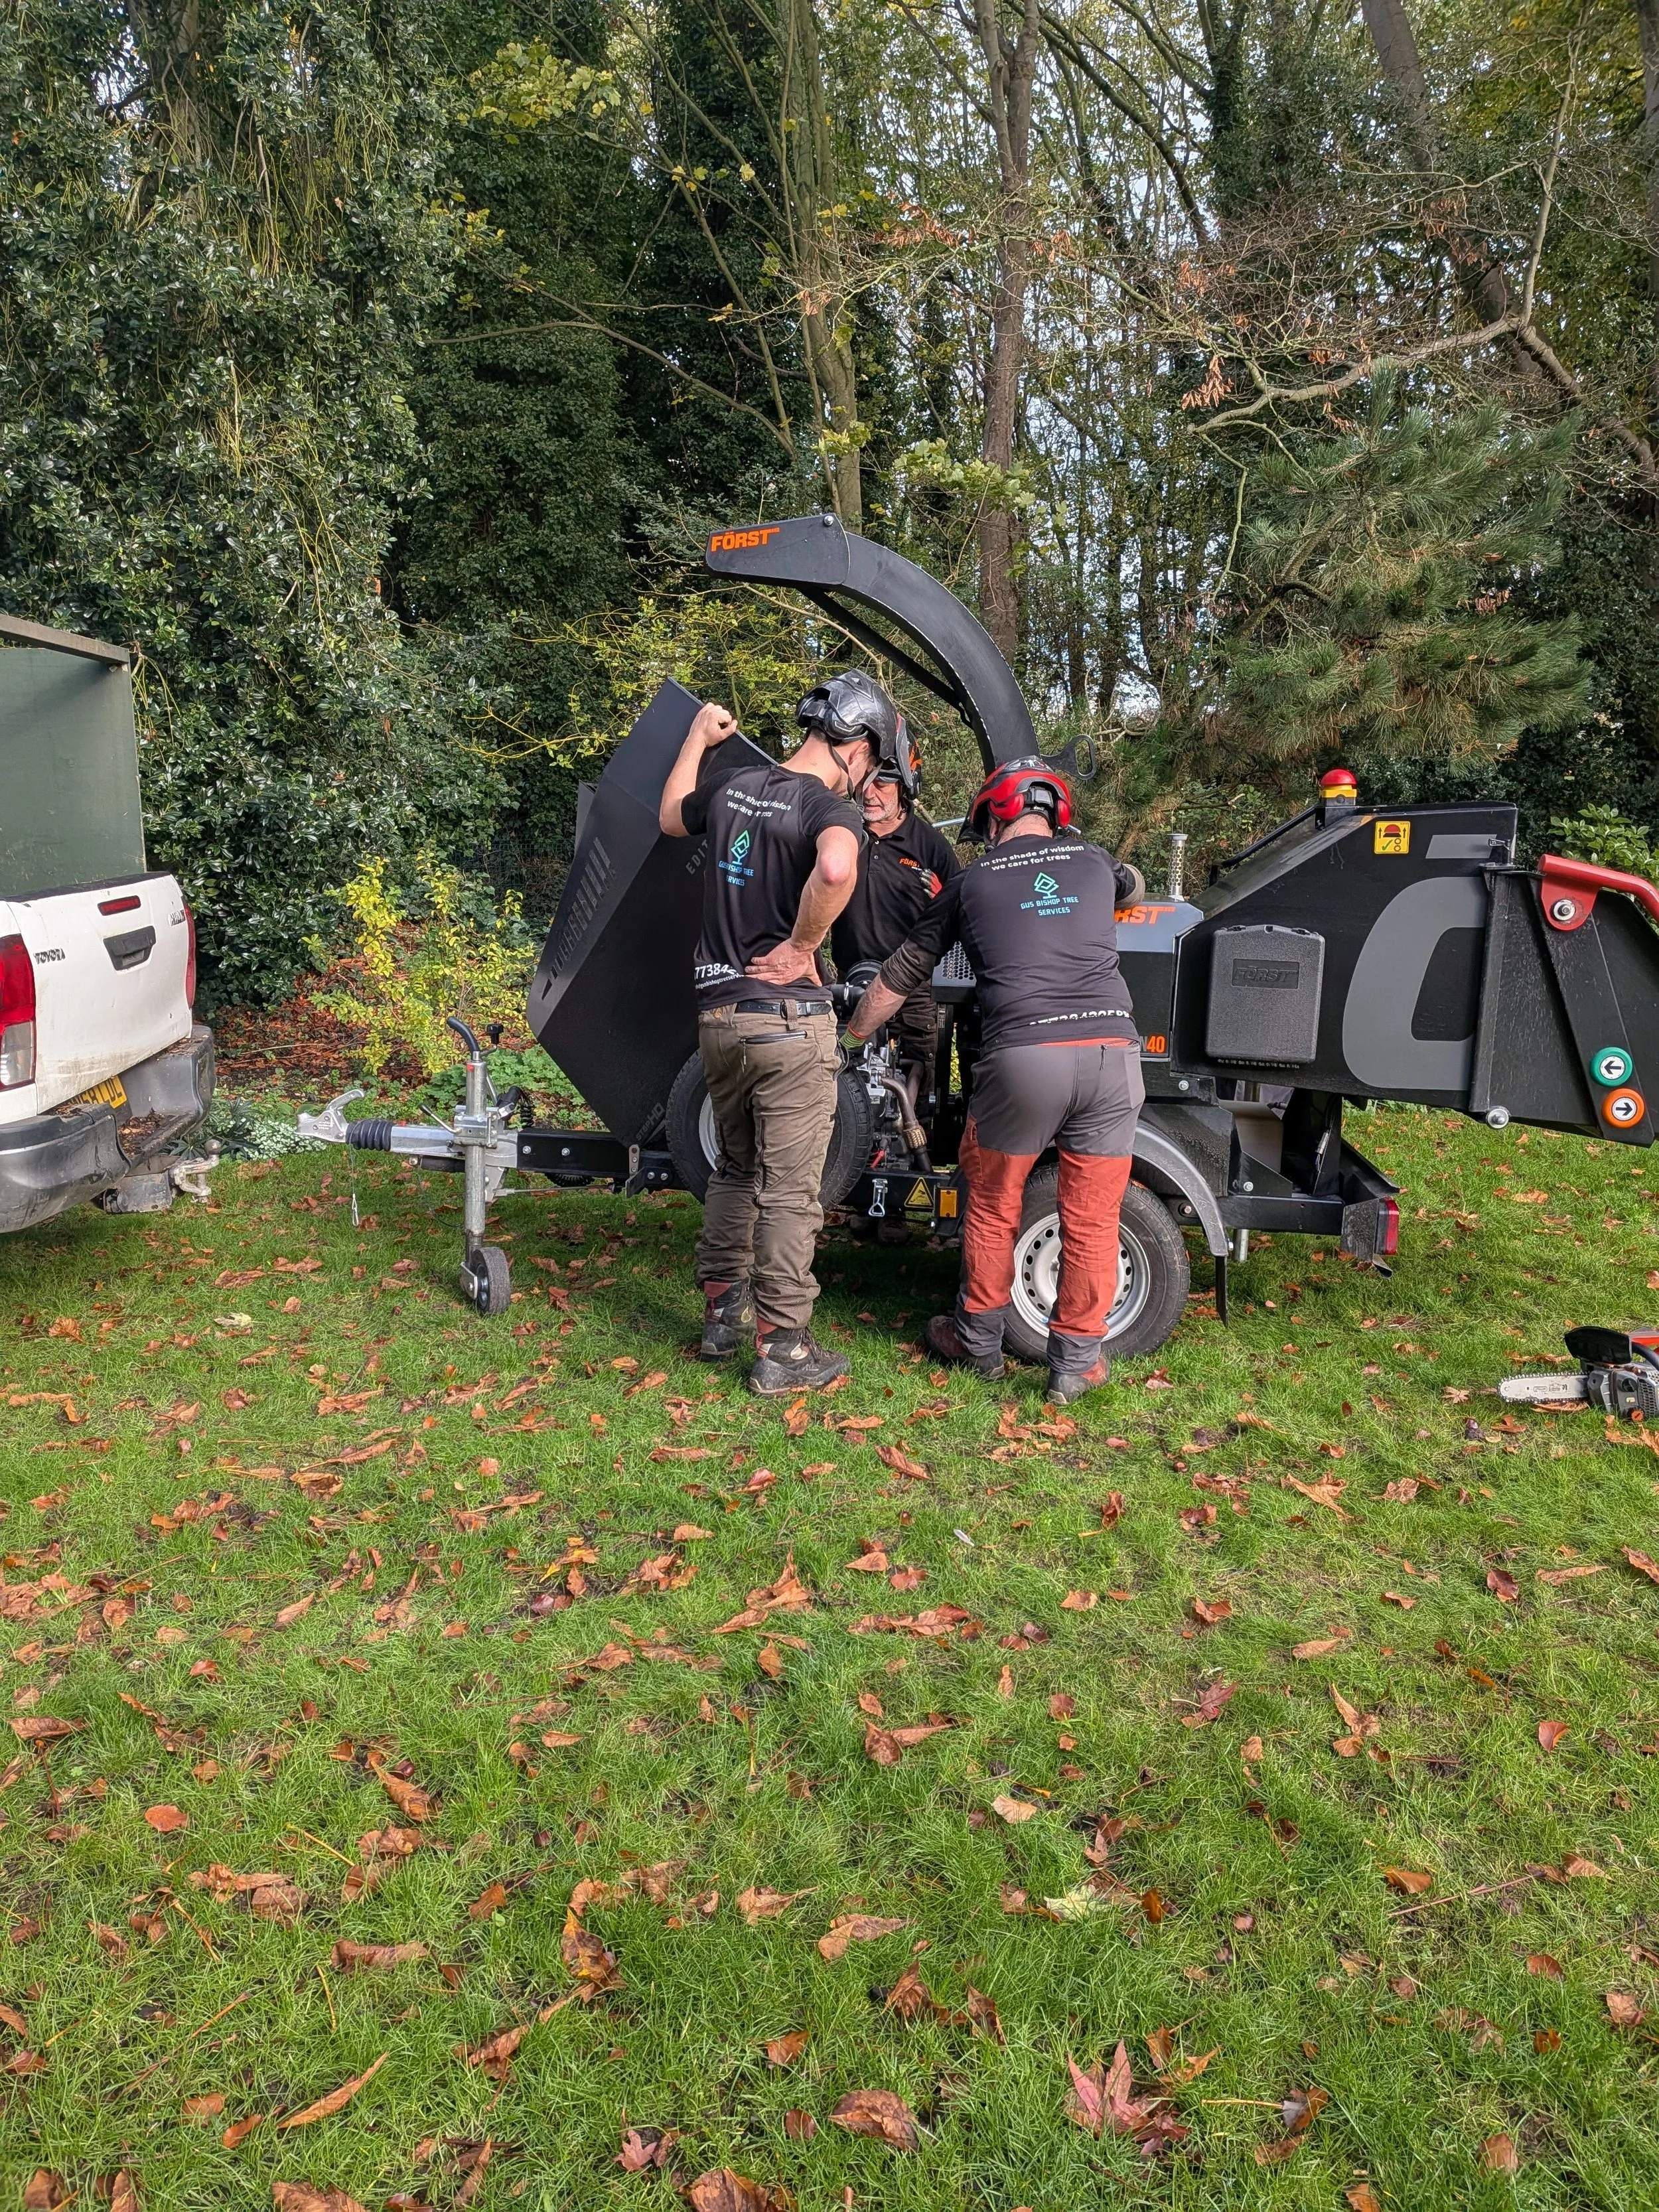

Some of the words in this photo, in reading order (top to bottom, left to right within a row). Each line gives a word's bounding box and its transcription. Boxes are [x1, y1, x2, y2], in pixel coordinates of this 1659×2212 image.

[711, 527, 780, 552] FÖRST
[1009, 851, 1037, 861] shade
[1050, 845, 1084, 853] wisdom
[1020, 901, 1035, 909] GUS
[1036, 898, 1060, 907] BISHOP
[1038, 907, 1071, 916] SERVICES
[33, 948, 66, 965] TOYOTA
